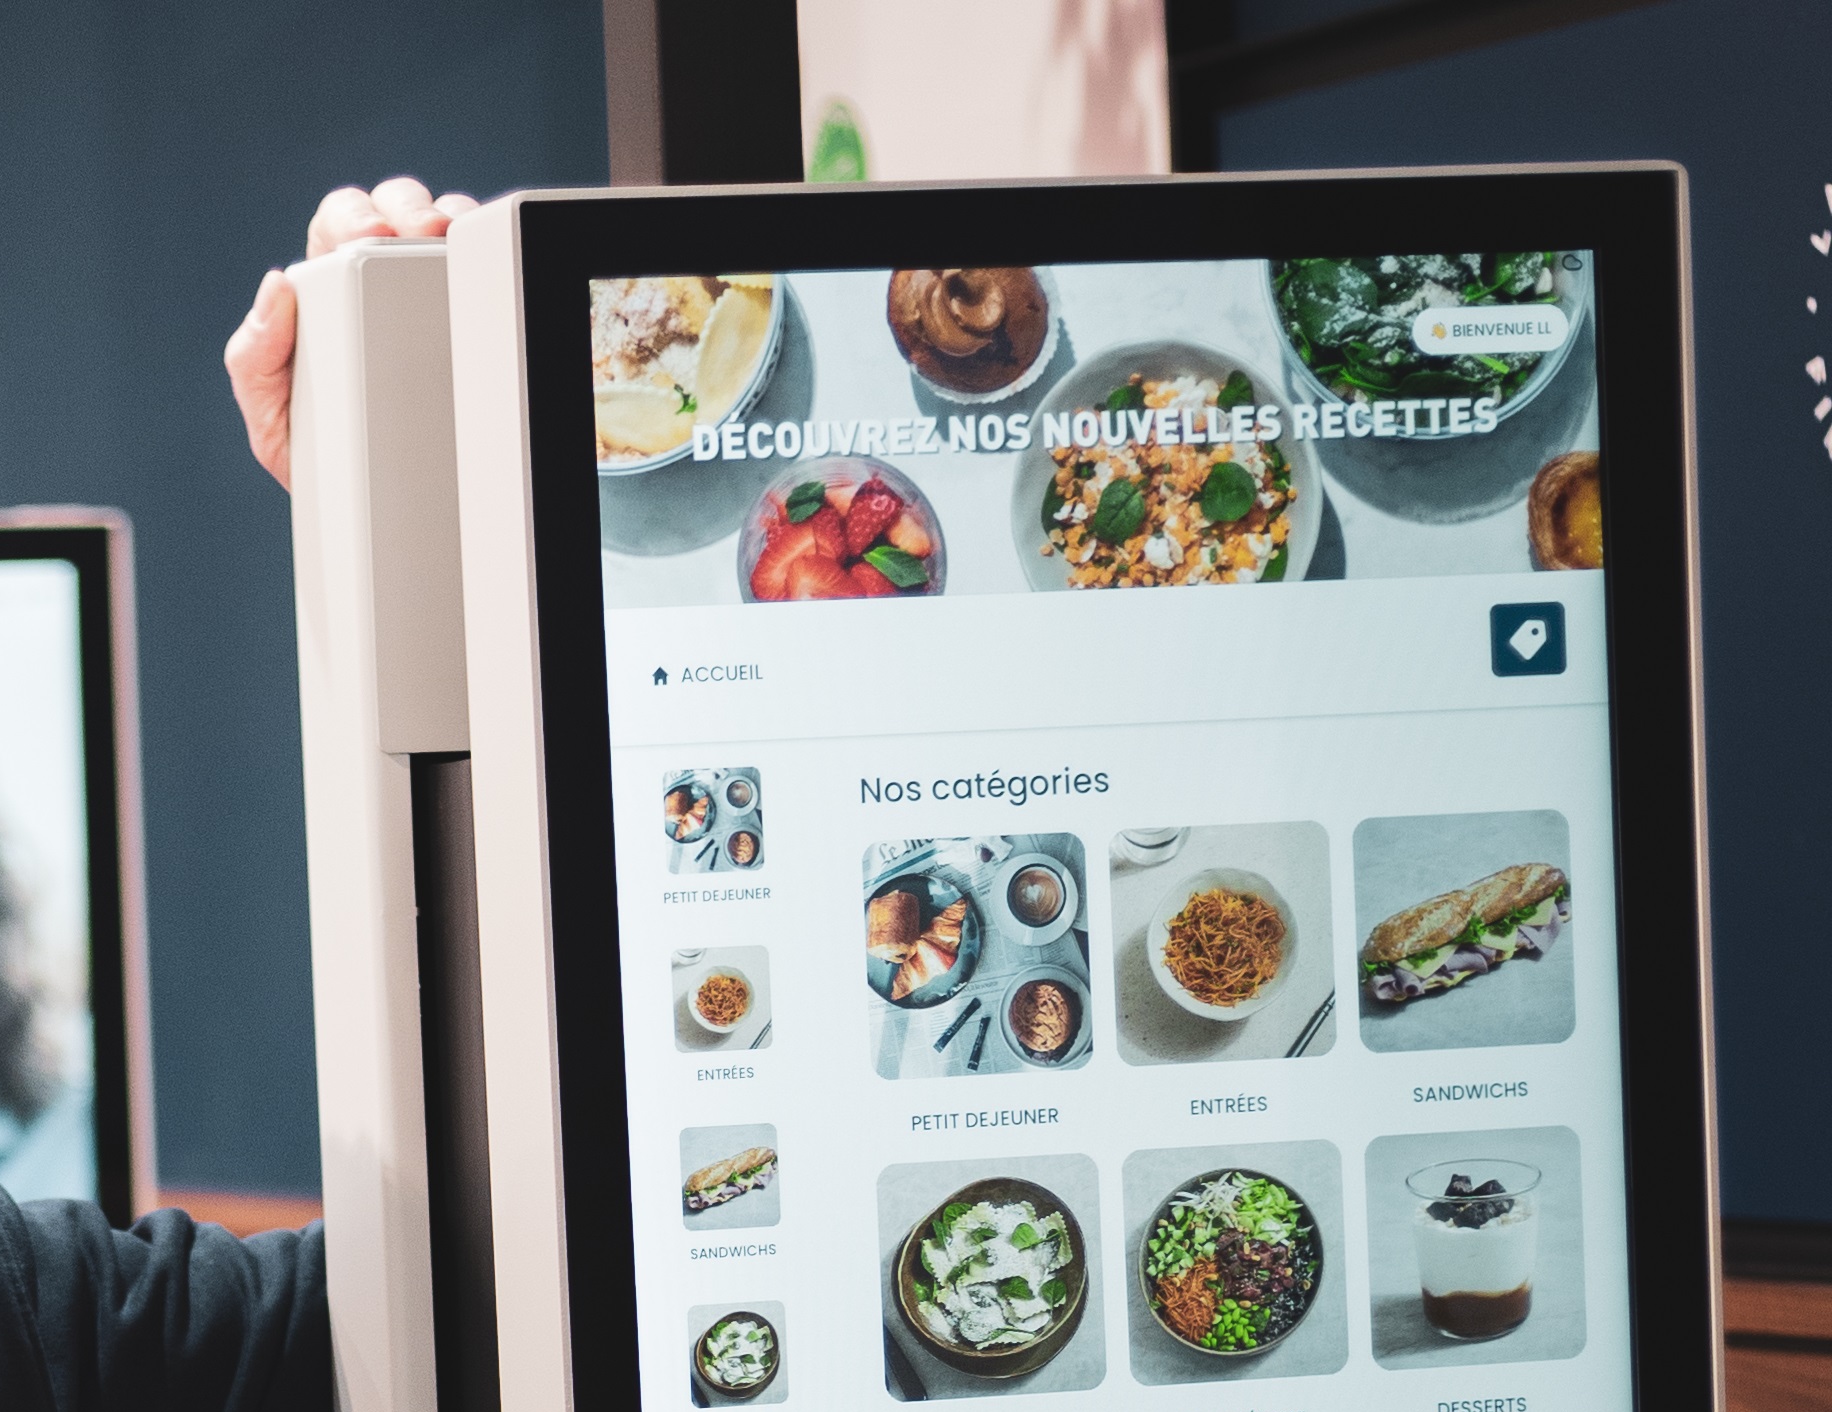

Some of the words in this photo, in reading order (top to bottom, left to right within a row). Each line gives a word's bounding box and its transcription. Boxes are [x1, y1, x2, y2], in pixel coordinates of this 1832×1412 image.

[1453, 322, 1532, 337] BIENVENUE
[1538, 322, 1551, 334] LL
[693, 413, 939, 461] DÉCOUVREZ
[949, 412, 1032, 453] NOS
[1043, 405, 1282, 449] NOUVELLES
[1293, 397, 1499, 440] RECETTES
[682, 665, 763, 682] ACCUEIL
[861, 778, 921, 803] Nos
[933, 767, 1109, 806] catégories
[664, 891, 698, 903] PETIT
[703, 888, 770, 901] DEJEUNER
[698, 1065, 754, 1081] ENTRÉES
[1414, 1082, 1528, 1102] SANDWICHS
[1191, 1094, 1267, 1115] ENTRÉES
[912, 1114, 959, 1131] PETIT
[966, 1108, 1058, 1127] DEJEUNER
[691, 1244, 776, 1259] SANDWICHS
